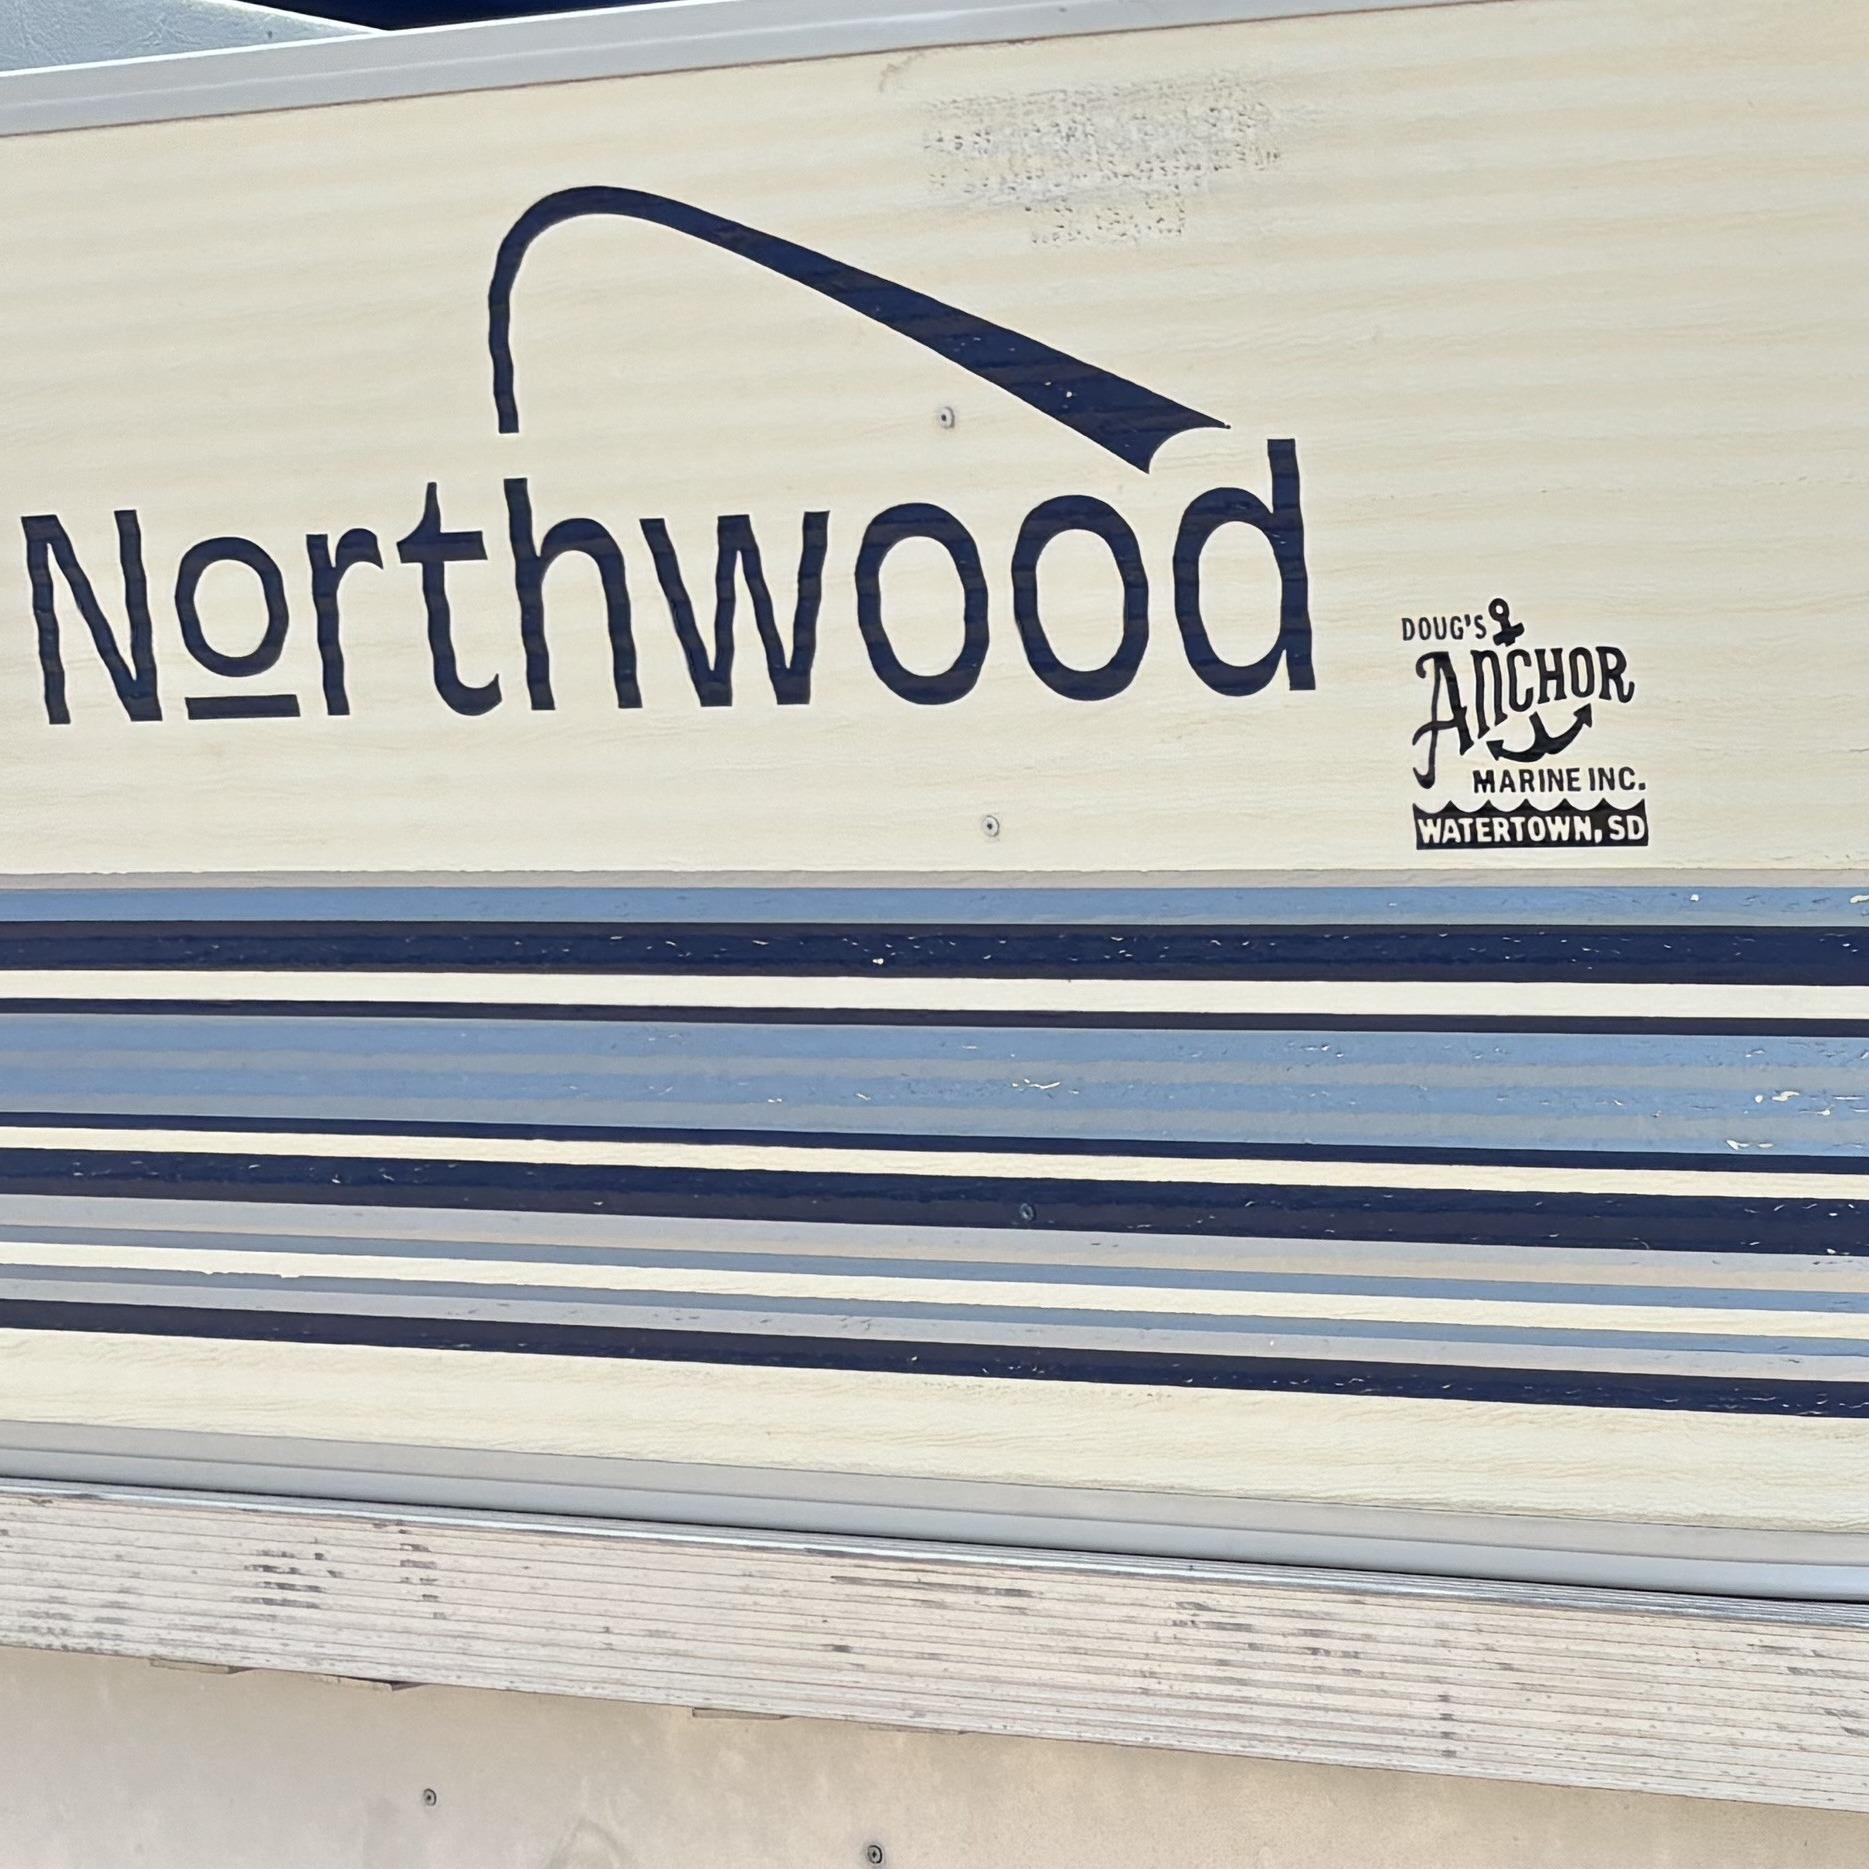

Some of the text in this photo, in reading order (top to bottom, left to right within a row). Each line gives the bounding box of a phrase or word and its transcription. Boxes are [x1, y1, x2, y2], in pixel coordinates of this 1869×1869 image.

[21, 437, 1317, 724] Northwood
[1401, 614, 1487, 641] DOUG'S
[1411, 645, 1635, 790] ANCHOR
[1472, 766, 1647, 793] MARINE INC.
[1416, 815, 1646, 844] WATERTOWN, SD
